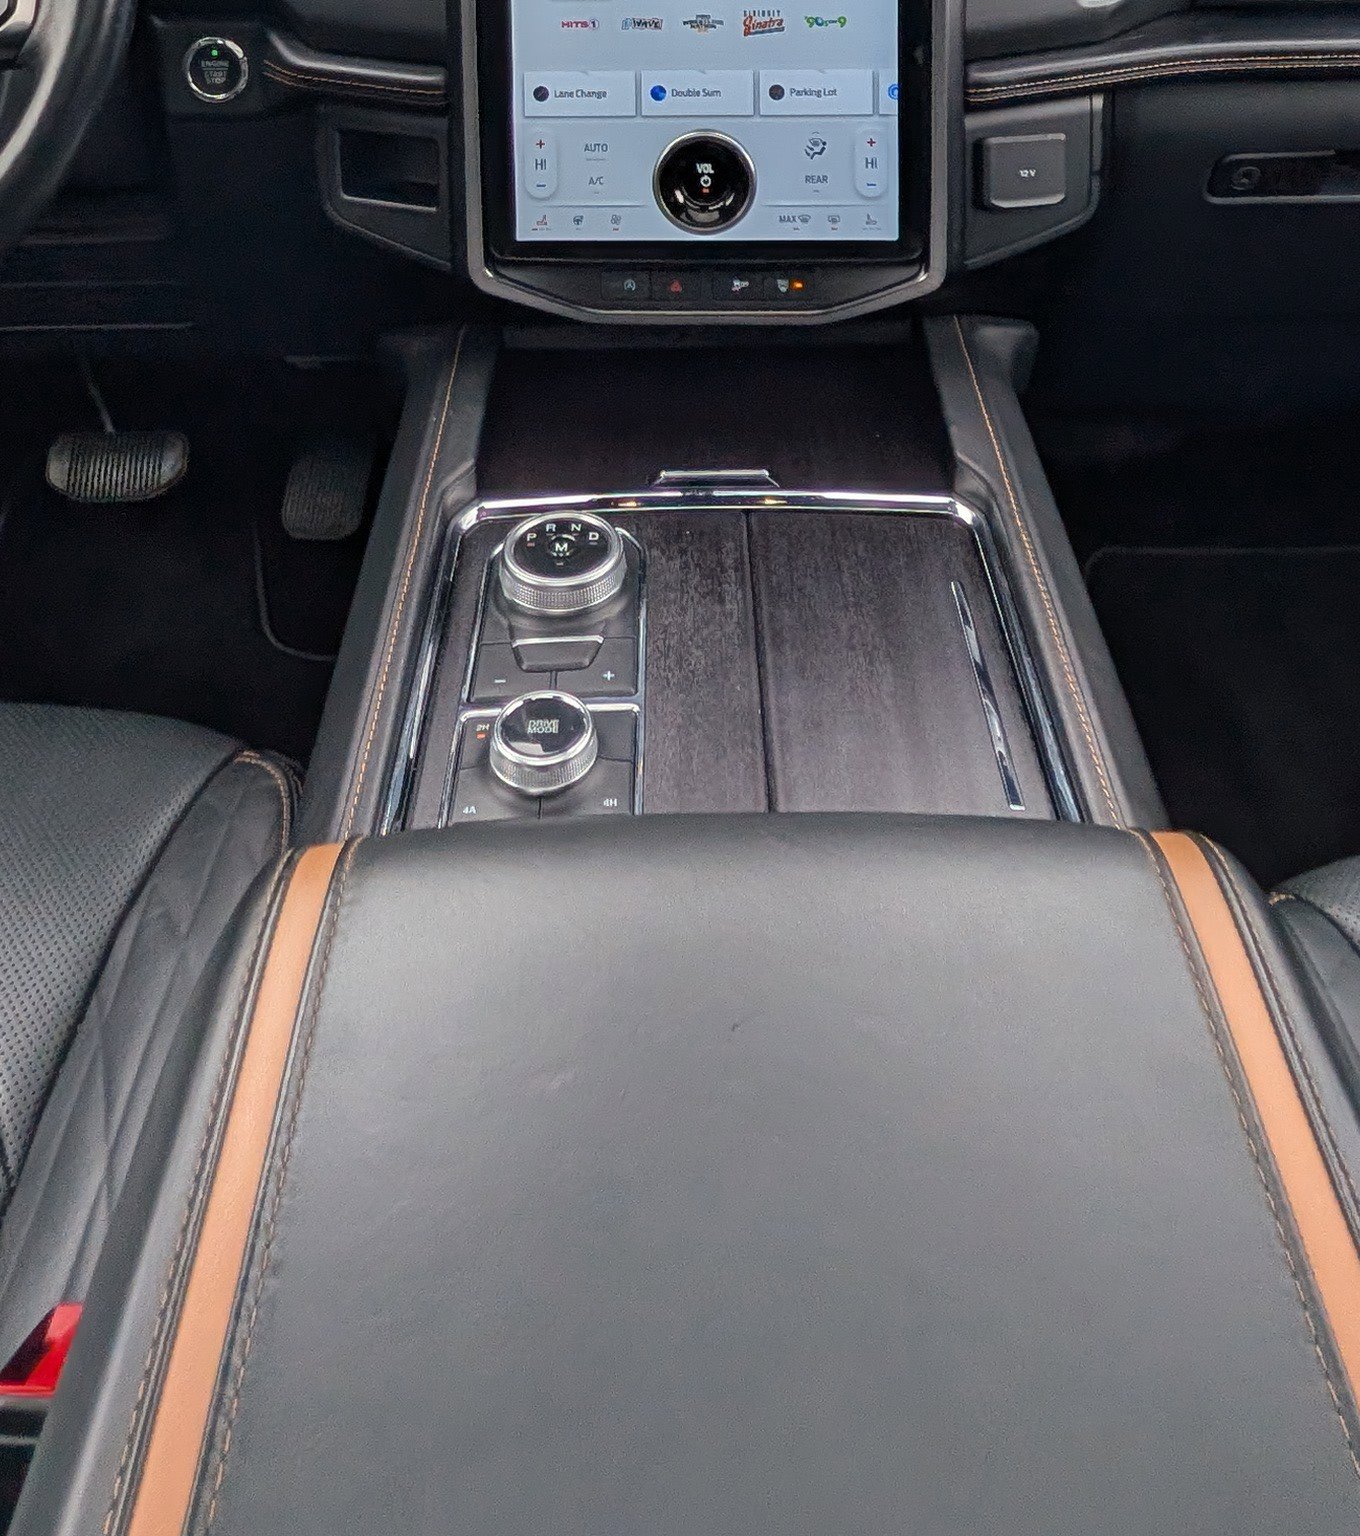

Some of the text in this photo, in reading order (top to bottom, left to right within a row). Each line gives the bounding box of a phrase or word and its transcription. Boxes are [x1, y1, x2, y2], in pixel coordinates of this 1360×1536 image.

[561, 20, 589, 28] HITS
[742, 15, 784, 37] Sinatra
[553, 89, 607, 100] Lane Change
[671, 88, 722, 97] Double Sum
[790, 87, 838, 98] Parking Lot
[584, 143, 609, 152] AUTO
[535, 158, 547, 171] HI
[865, 157, 878, 169] HI
[696, 162, 715, 174] VOL
[588, 176, 604, 185] A/C
[804, 175, 829, 184] REAR
[778, 215, 797, 223] MAX
[526, 523, 600, 542] P R N D
[555, 542, 568, 552] M
[528, 718, 560, 727] DRIVE
[526, 726, 559, 734] MODE
[603, 797, 618, 807] 4H
[462, 805, 477, 814] 4A
